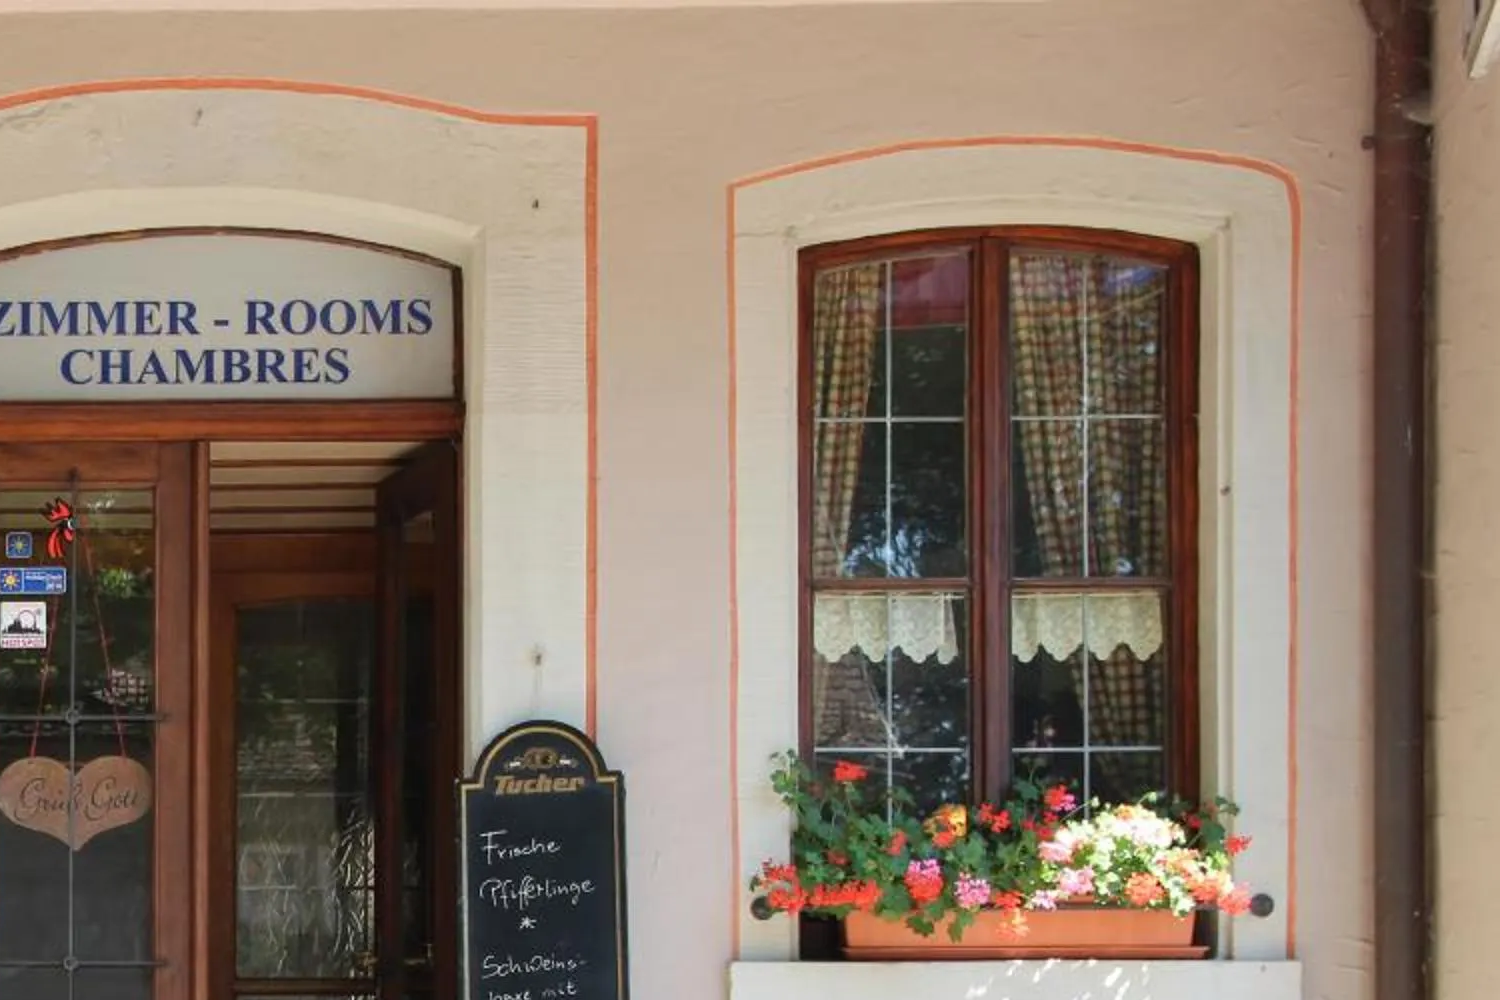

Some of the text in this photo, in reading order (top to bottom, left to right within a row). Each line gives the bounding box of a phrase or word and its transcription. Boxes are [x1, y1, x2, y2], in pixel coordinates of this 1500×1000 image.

[244, 299, 434, 336] ROOMS
[60, 347, 351, 386] CHAMBRES
[495, 774, 586, 796] Tucher
[479, 829, 561, 865] Frische
[542, 980, 578, 997] mit
